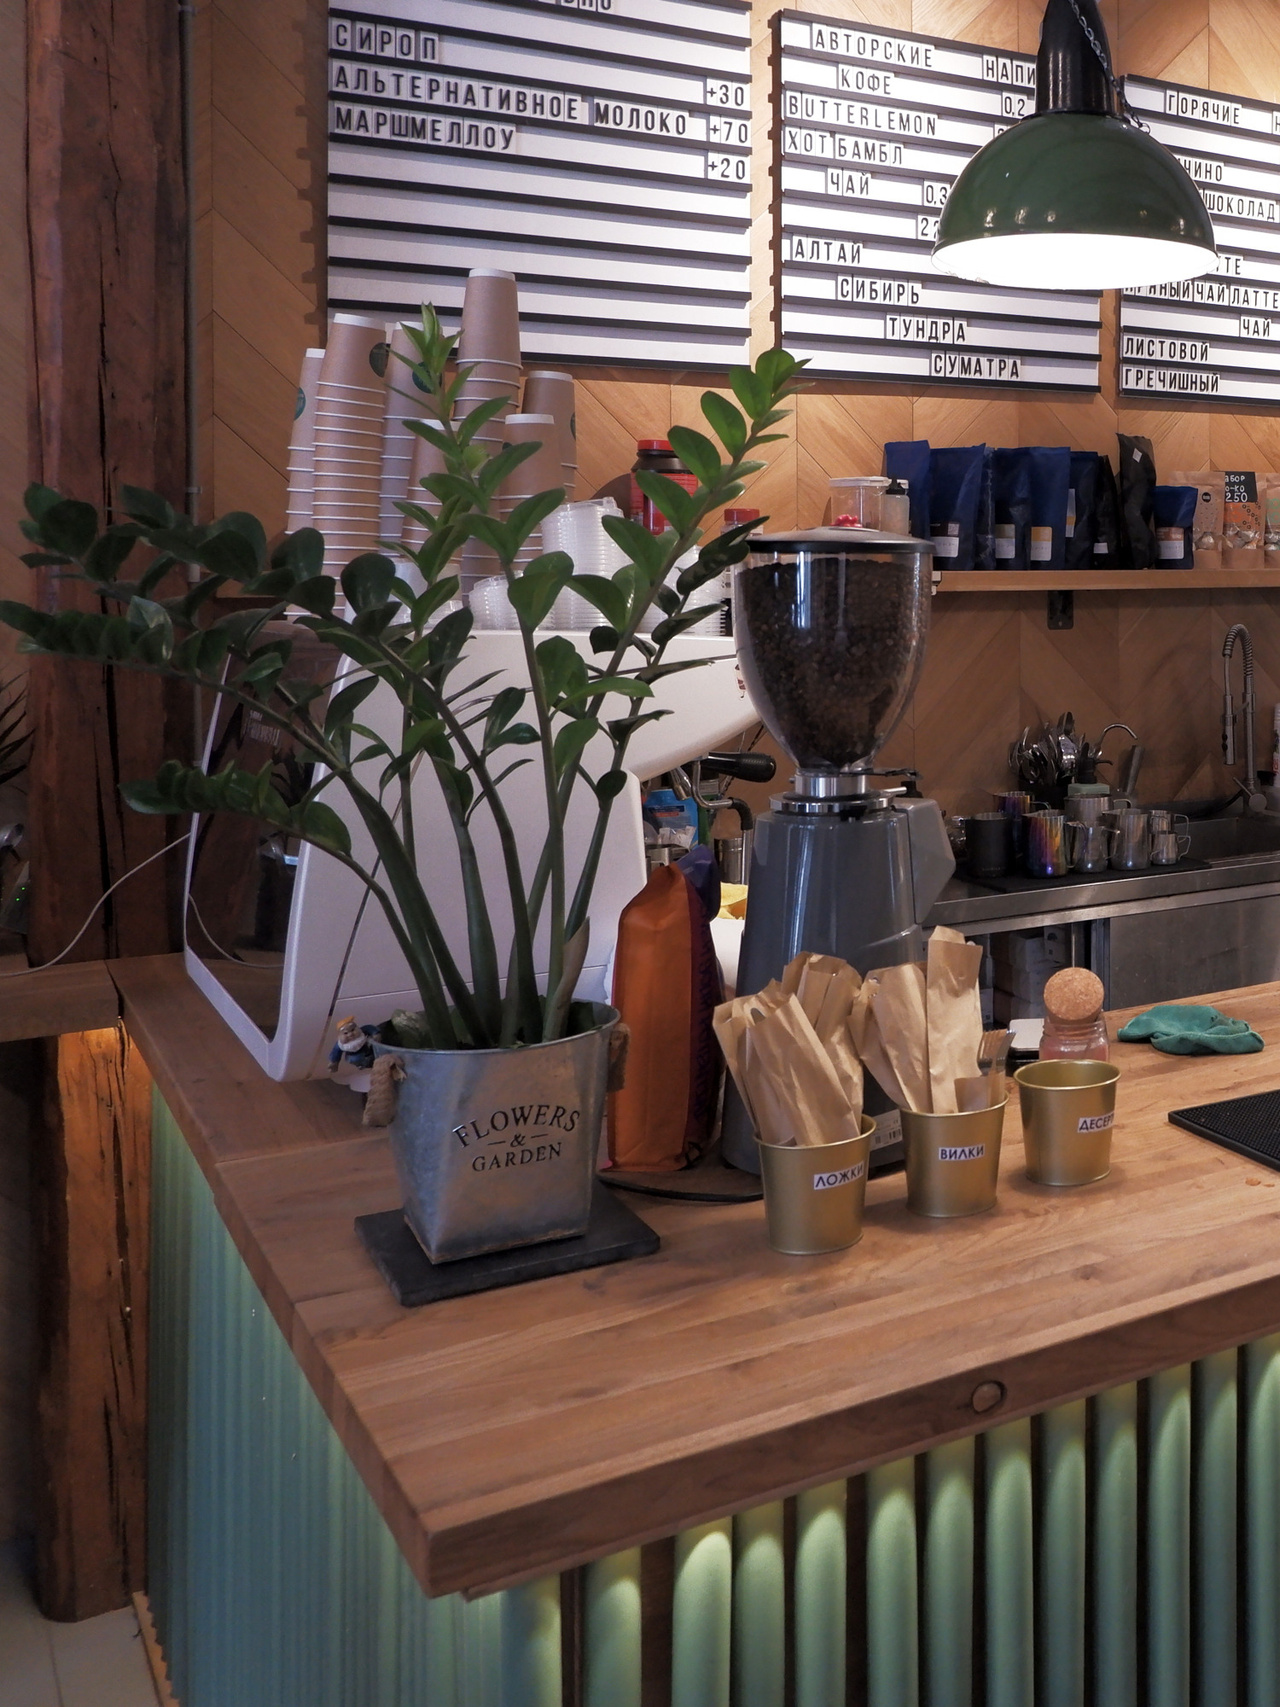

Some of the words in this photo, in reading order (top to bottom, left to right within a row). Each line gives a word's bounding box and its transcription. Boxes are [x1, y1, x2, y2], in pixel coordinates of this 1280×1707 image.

[335, 23, 437, 60] СИРОП
[706, 84, 745, 107] +30
[815, 29, 933, 68] АВТОРСКИЕ
[986, 59, 1036, 86] НАПИ
[335, 65, 578, 120] АЛЬТЕРНАТИВНОЕ
[594, 102, 688, 135] МОЛОКО
[709, 121, 749, 144] +70
[841, 69, 892, 95] КОФЕ
[1004, 96, 1026, 117] 0,2
[789, 95, 937, 136] BUTTERLEMON
[1168, 94, 1240, 124] ГОРЯЧИЕ
[335, 107, 515, 150] МАРШМЕЛЛОУ
[707, 158, 746, 180] +20
[788, 130, 827, 154] ХОТ
[838, 138, 903, 164] БАМБЛ
[830, 171, 869, 195] ЧАЙ
[795, 238, 861, 264] АЛТАЙ
[840, 278, 920, 304] СИБИРЬ
[1197, 283, 1226, 303] ЧАЙ
[1231, 288, 1279, 310] ЛАТТЕ
[889, 317, 966, 342] ТУНДРА
[1243, 317, 1271, 338] ЧАЙ
[1124, 338, 1209, 362] ЛИСТОВОЙ
[934, 354, 1020, 379] СУМАТРА
[1124, 368, 1219, 393] ГРЕЧИШНЫЙ
[1225, 492, 1248, 503] 250
[452, 1104, 581, 1148] FLOWERS
[510, 1134, 526, 1148] &
[940, 1144, 985, 1161] ВИЛКИ
[472, 1142, 563, 1172] GARDEN
[814, 1164, 864, 1190] ЛОЖКИ
